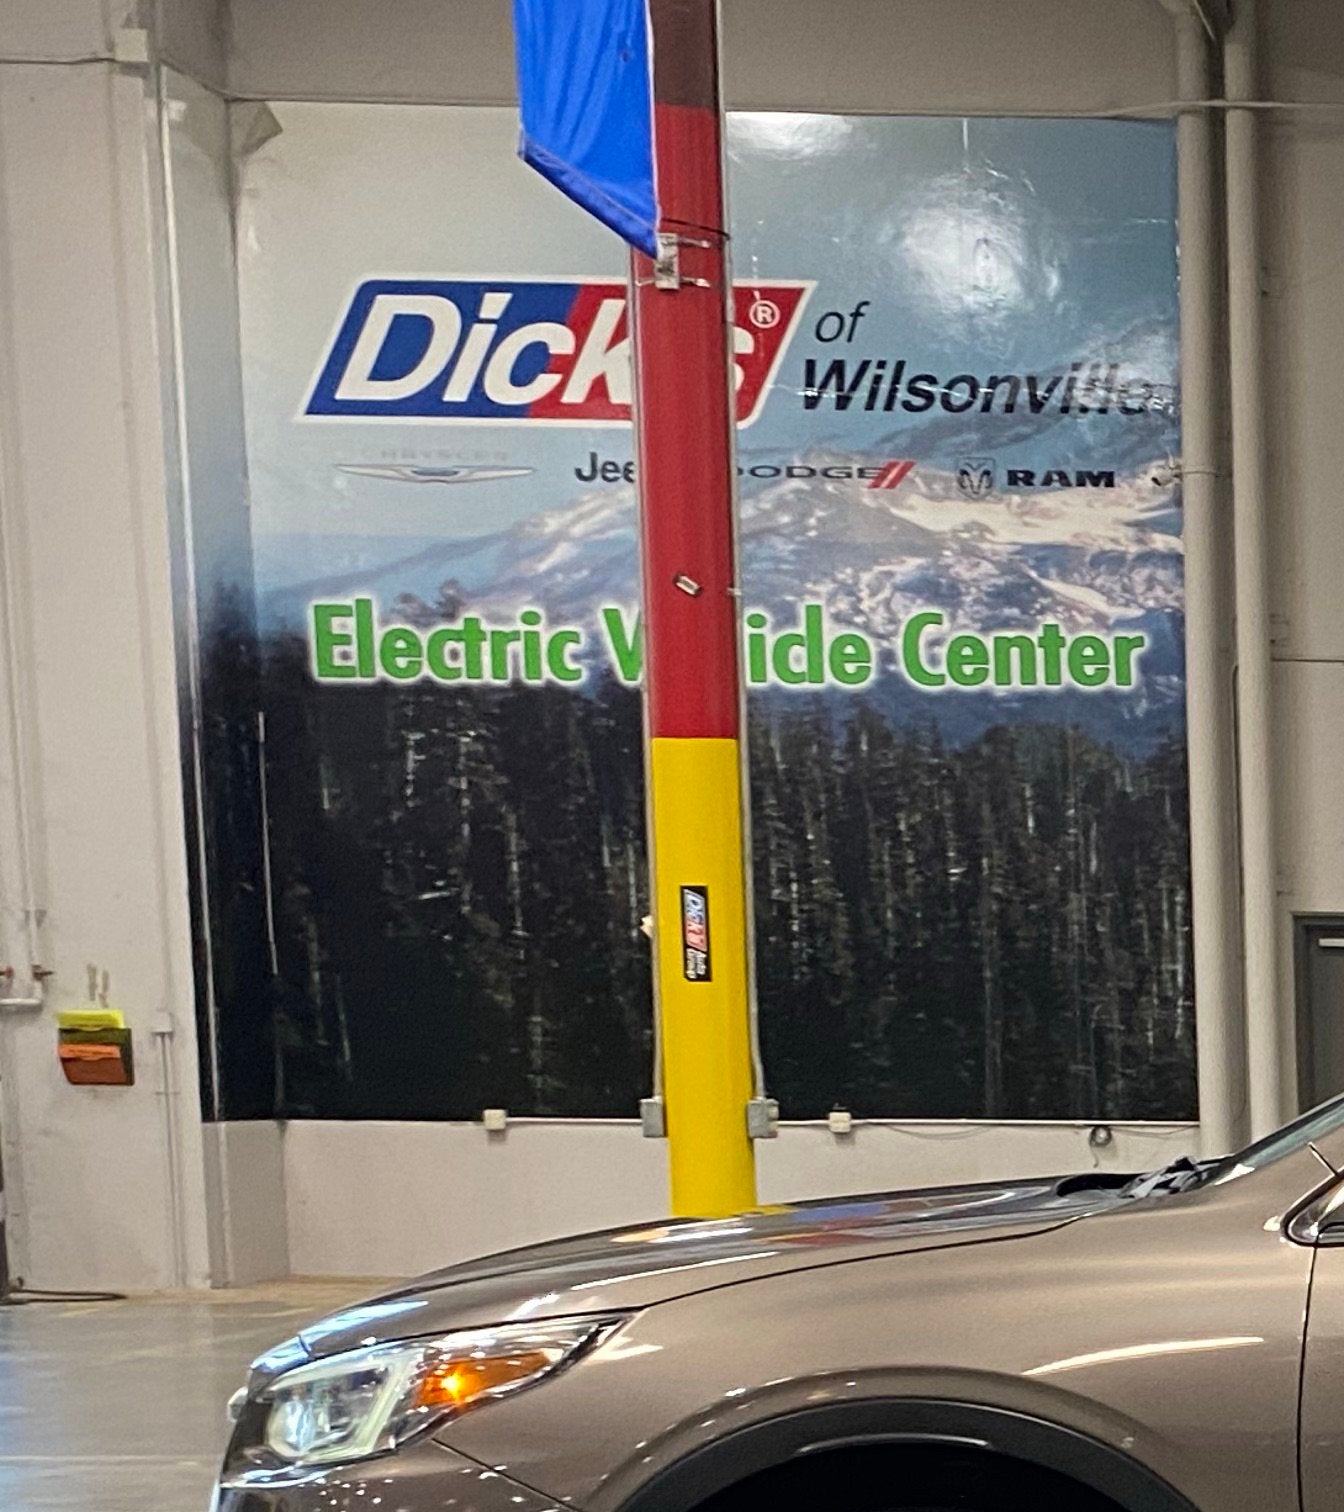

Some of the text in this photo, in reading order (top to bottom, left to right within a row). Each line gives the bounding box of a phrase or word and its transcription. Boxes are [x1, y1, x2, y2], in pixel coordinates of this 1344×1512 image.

[334, 291, 870, 406] Dick of
[575, 451, 635, 483] Jee
[737, 465, 886, 479] ODGE
[1007, 468, 1115, 488] RAM
[313, 598, 1145, 687] Electric Vicle Center
